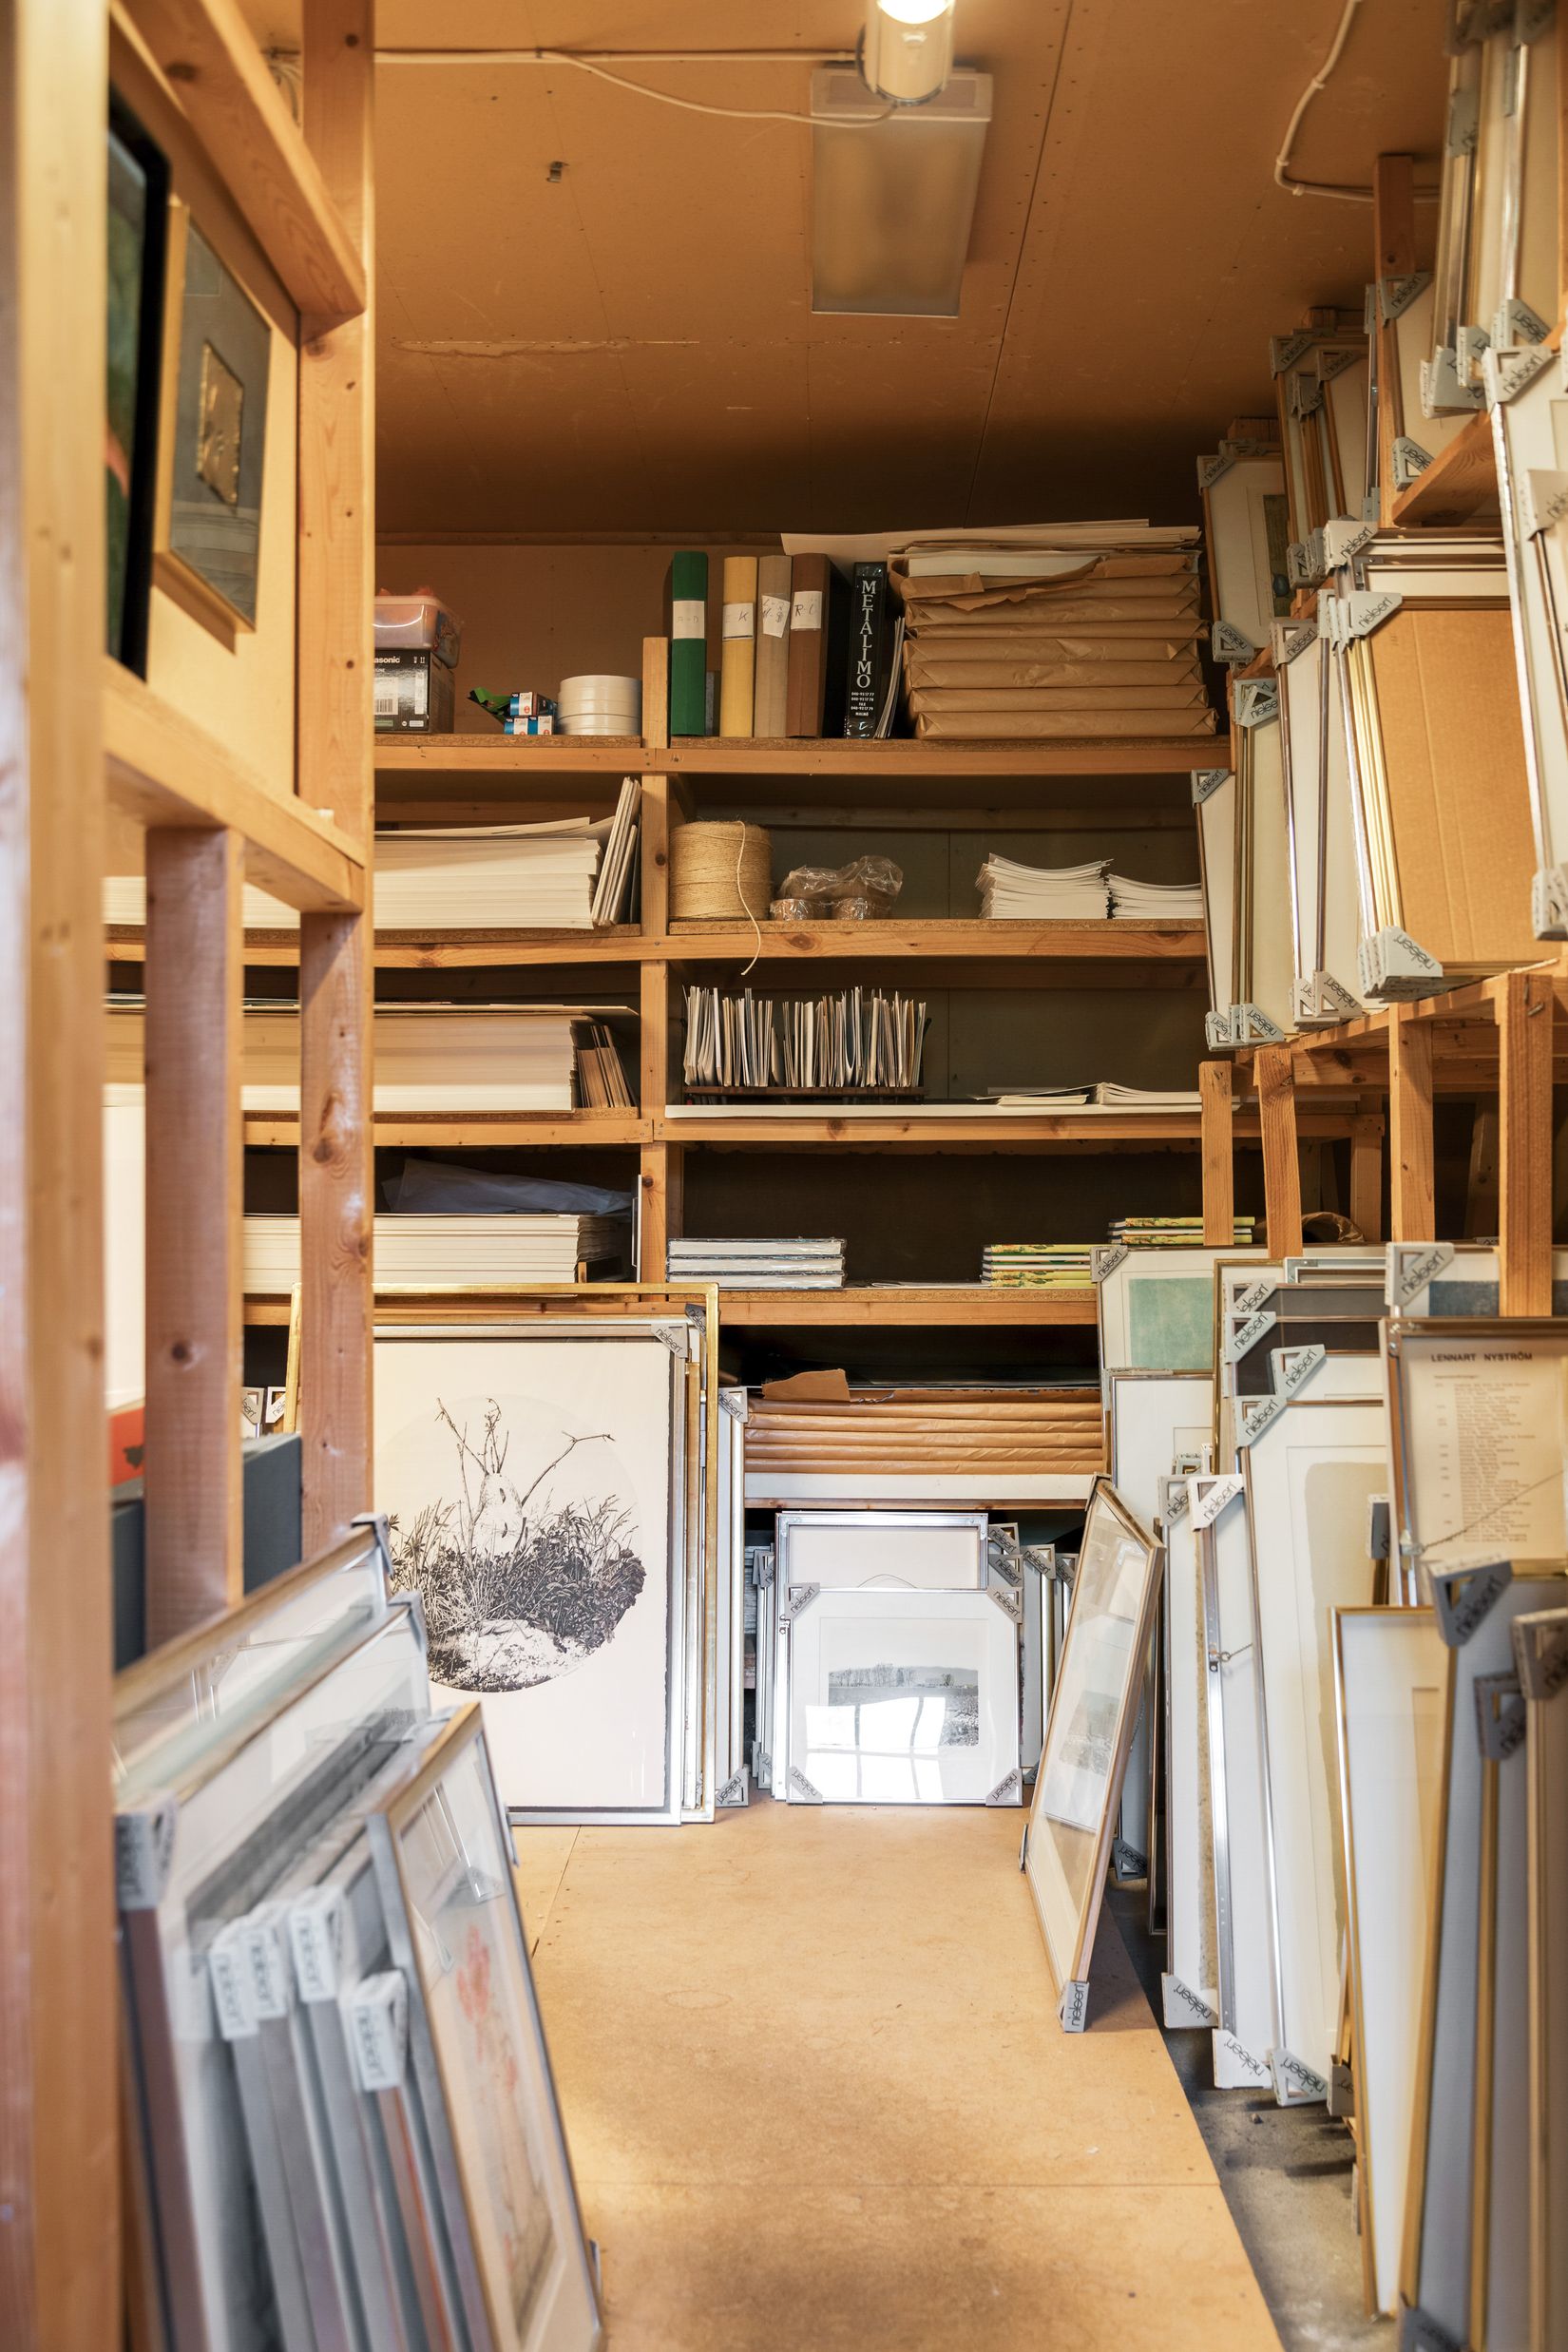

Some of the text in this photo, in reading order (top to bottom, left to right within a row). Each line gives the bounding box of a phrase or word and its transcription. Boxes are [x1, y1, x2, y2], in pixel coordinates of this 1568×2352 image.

[1391, 276, 1421, 307] nielsen
[1503, 352, 1545, 394] nielsen
[1204, 457, 1227, 481] nielsen
[1340, 526, 1373, 559] nielsen
[1359, 597, 1393, 627] nielsen
[856, 580, 876, 689] METALIMO
[1218, 626, 1247, 650] nielsen
[1287, 628, 1315, 656] nielsen
[1198, 771, 1222, 795] nielsen
[1394, 934, 1434, 969] nielsen
[1322, 978, 1358, 1008] nielsen
[1247, 1009, 1277, 1036] nielsen
[1098, 1250, 1122, 1277] nielsen
[1401, 1251, 1444, 1295] nielsen
[1236, 1283, 1268, 1311] ielsen
[655, 1329, 683, 1353] nielsen
[1234, 1311, 1268, 1350] nielsen
[1286, 1348, 1317, 1388] nielsen
[1430, 1350, 1533, 1363] LENNART NYSTRÖM
[1245, 1399, 1278, 1437] nielsen
[1203, 1482, 1237, 1520] nielsen
[989, 1528, 1016, 1553] nielsen
[995, 1558, 1022, 1584] nielsen
[1024, 1550, 1051, 1575] nielsen
[791, 1585, 815, 1614] nielsen
[993, 1591, 1020, 1616] nielsen
[717, 1776, 742, 1804] nielsen
[792, 1769, 818, 1796] nielsen
[992, 1773, 1017, 1801] nielsen
[1069, 1983, 1084, 2026] nielsen
[1174, 1983, 1212, 2019] nielsen
[1223, 2038, 1263, 2076] nielsen
[1280, 2057, 1326, 2094] nielsen
